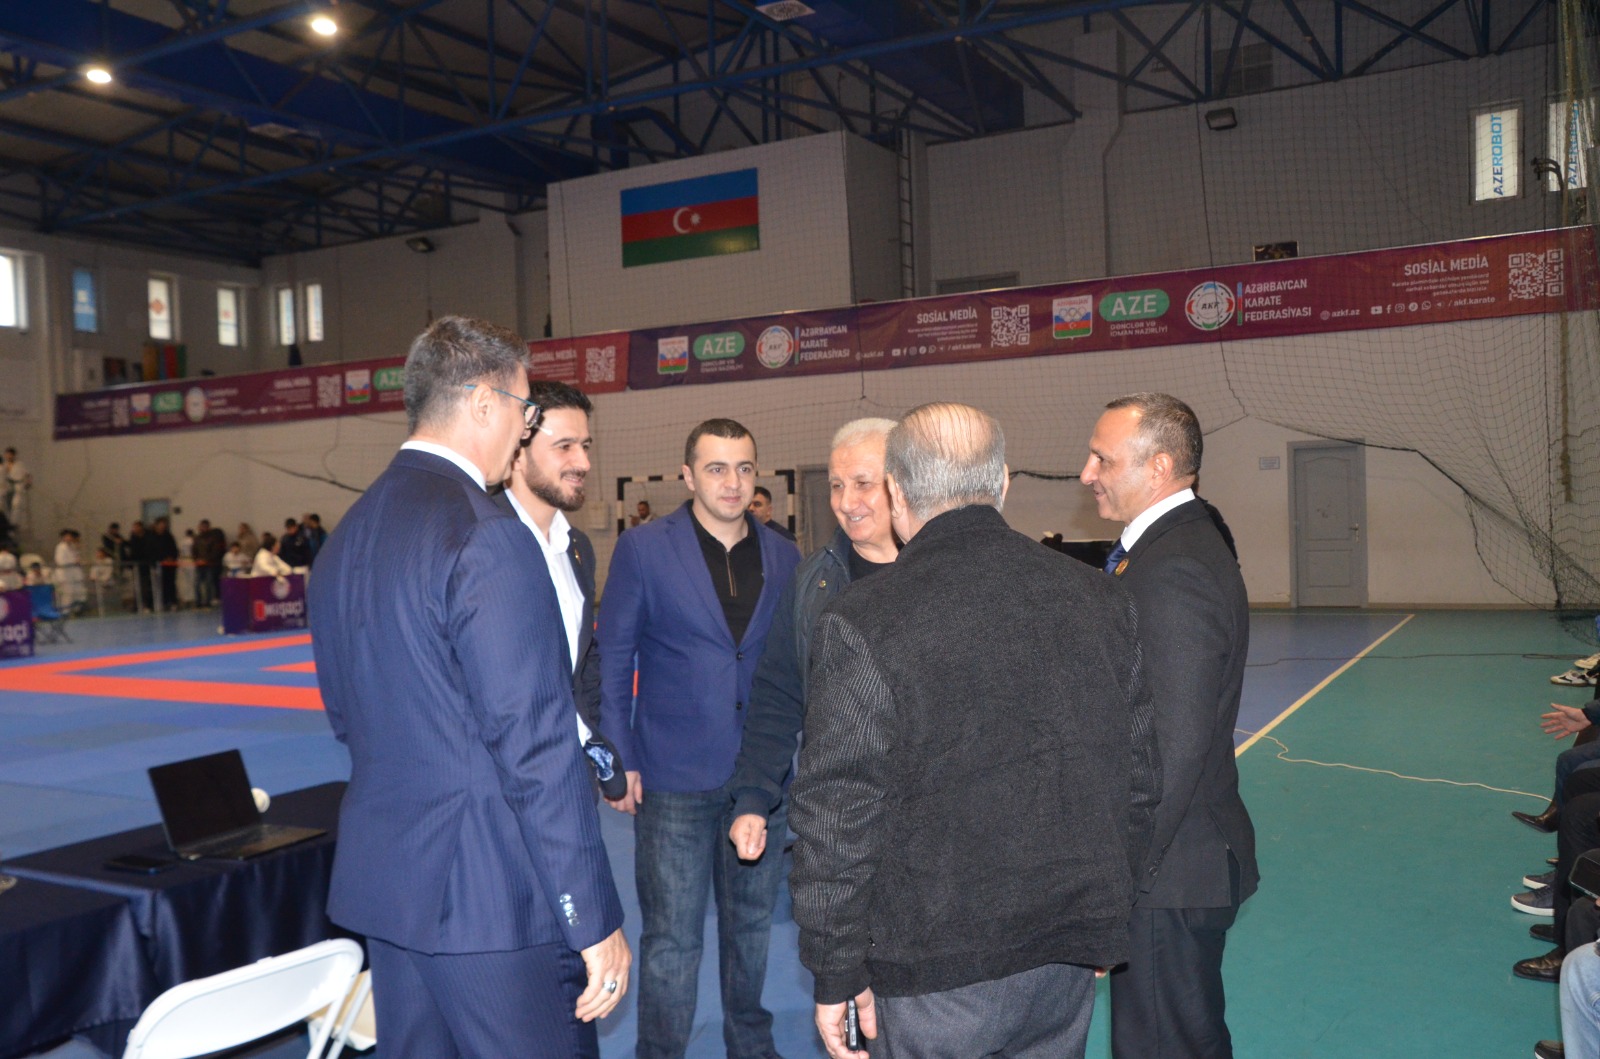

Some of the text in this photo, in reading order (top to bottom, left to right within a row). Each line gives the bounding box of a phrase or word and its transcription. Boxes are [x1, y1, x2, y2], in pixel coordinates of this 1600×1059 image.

[1491, 114, 1504, 196] AZEROBOT
[1404, 254, 1489, 276] SOSİAL MEDİA
[1244, 279, 1307, 294] AZƏRBAYCAN
[1111, 294, 1157, 316] AZE
[1244, 295, 1282, 308] KARATE
[917, 306, 978, 324] SOSİAL MEDİA
[1244, 306, 1311, 322] FEDERASİYASI
[1331, 308, 1361, 317] azkf.az
[702, 336, 736, 356] AZE
[800, 338, 828, 349] KARATE
